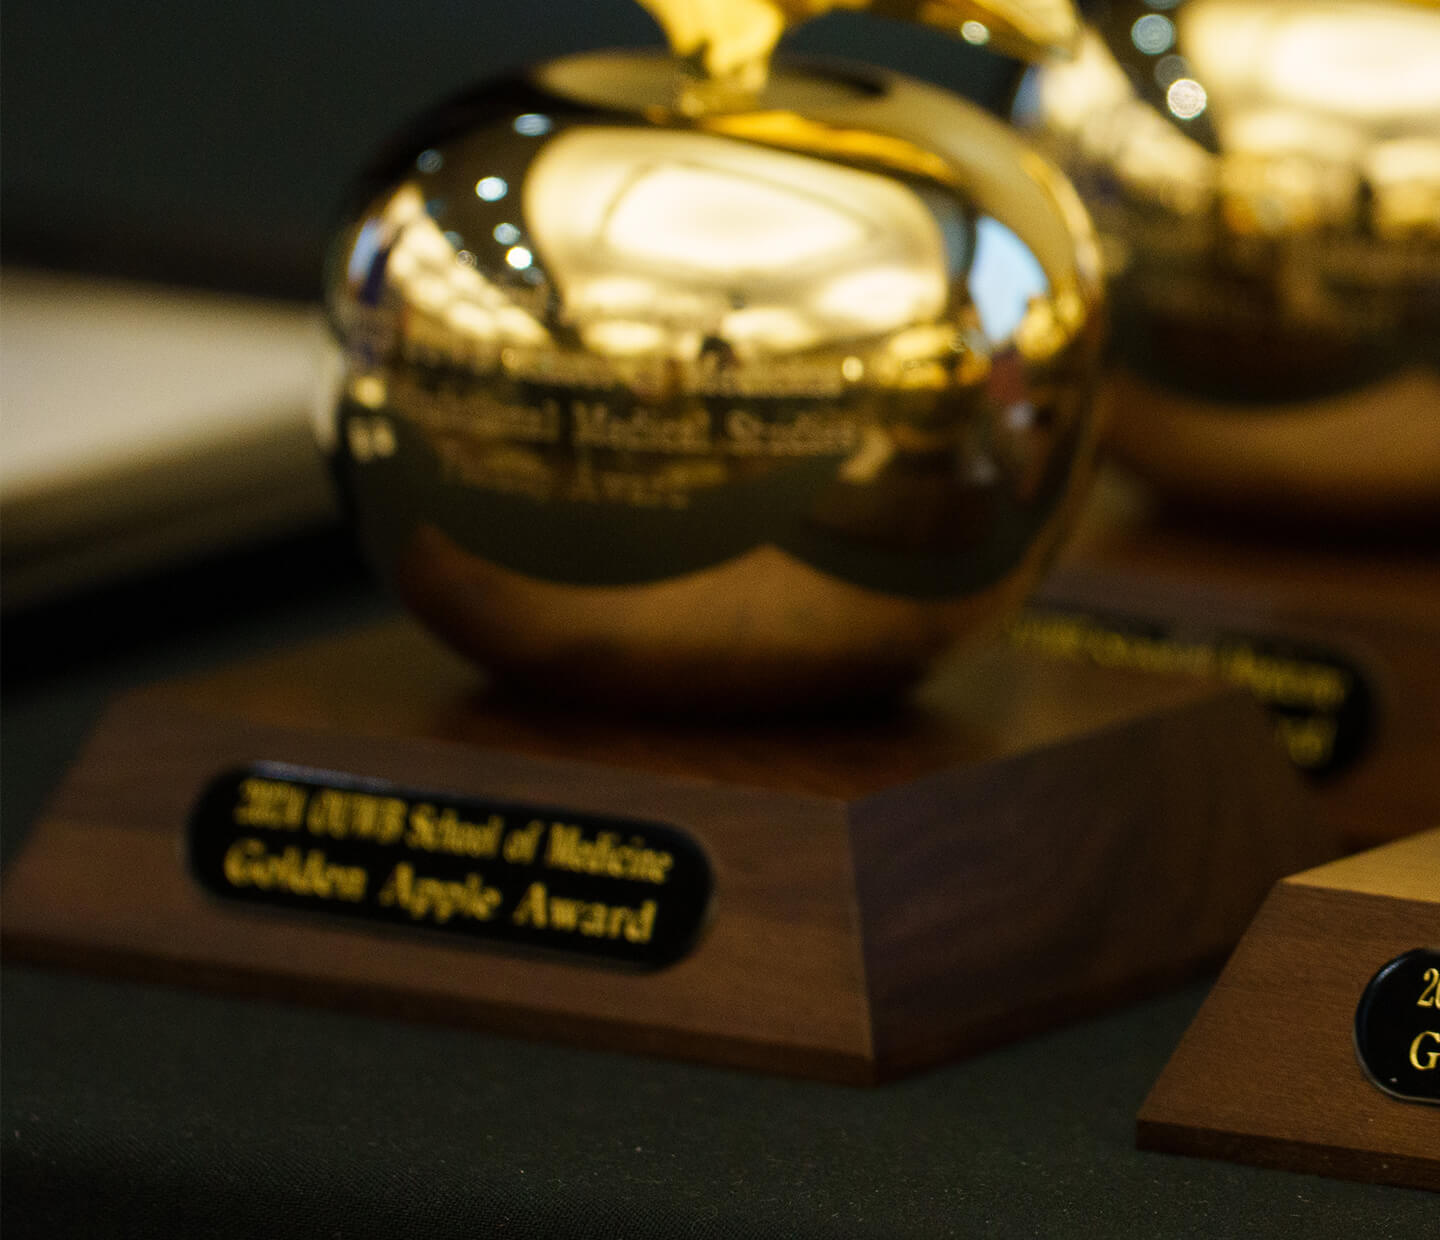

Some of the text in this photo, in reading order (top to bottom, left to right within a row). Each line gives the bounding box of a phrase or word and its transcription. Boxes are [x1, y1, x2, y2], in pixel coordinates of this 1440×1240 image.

[223, 838, 658, 944] Golden Apple Award
